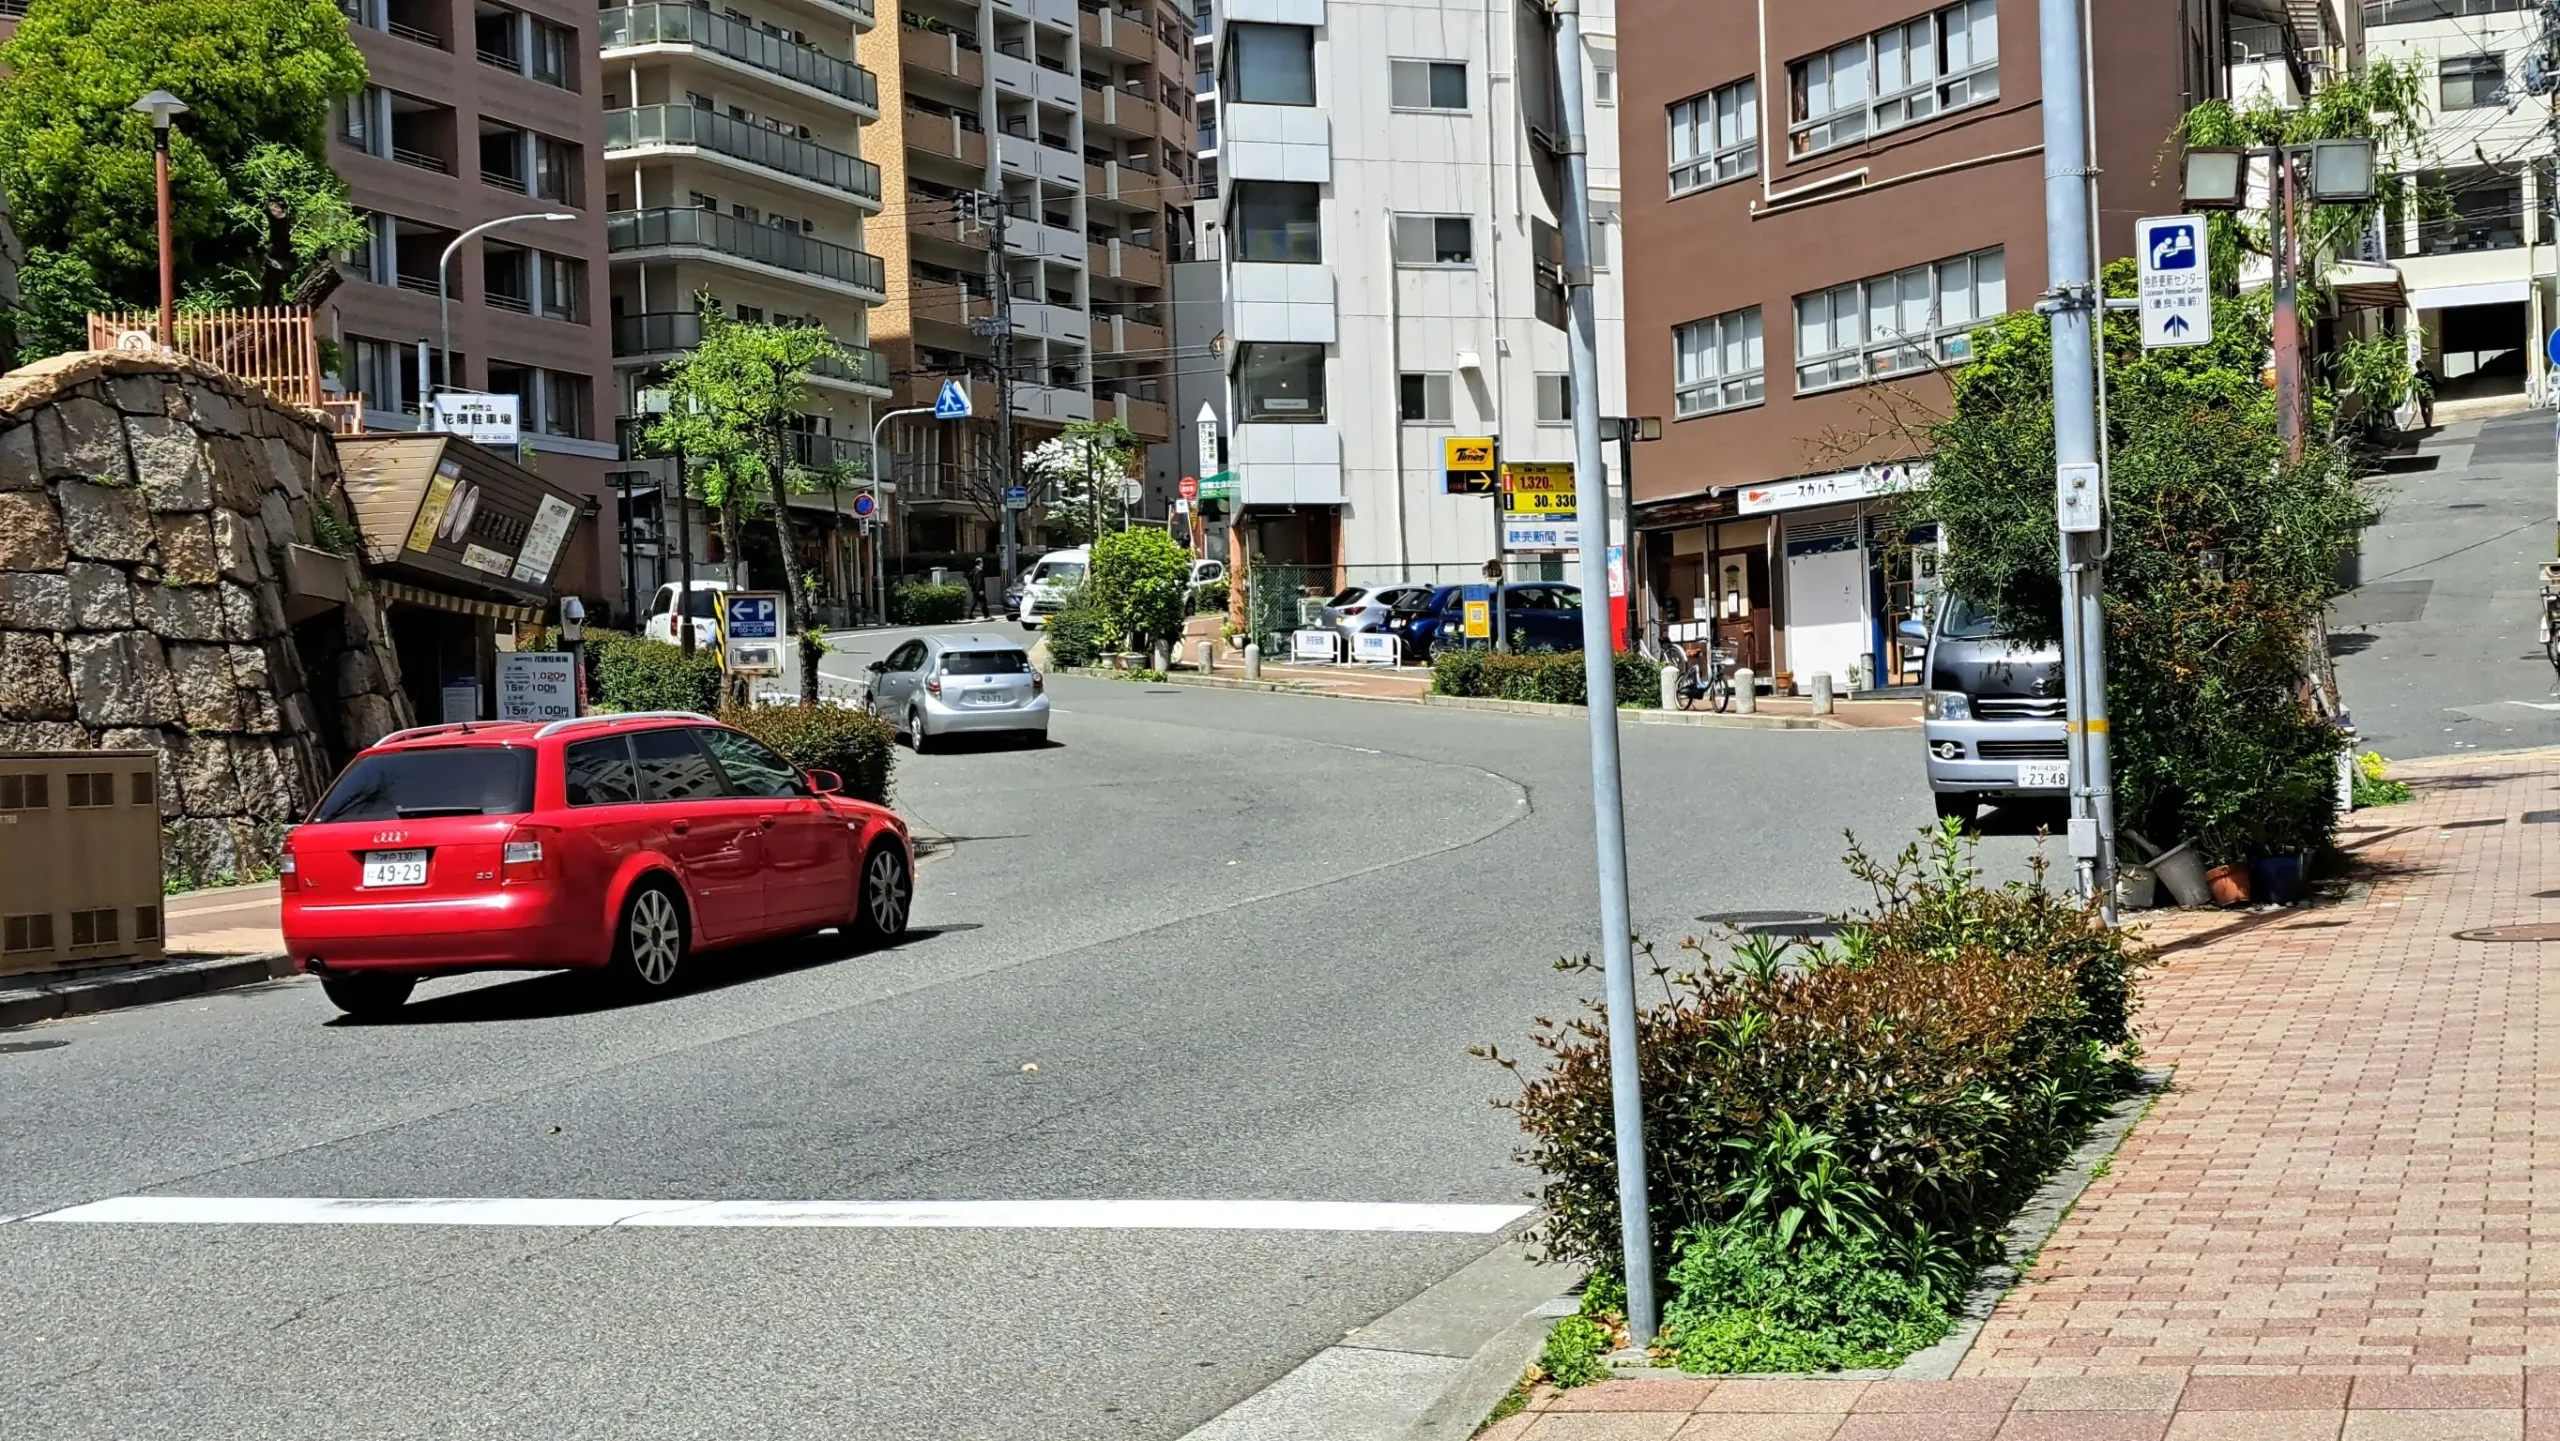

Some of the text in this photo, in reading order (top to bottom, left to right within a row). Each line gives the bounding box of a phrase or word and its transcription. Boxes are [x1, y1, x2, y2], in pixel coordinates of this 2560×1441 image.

[2144, 273, 2204, 288] 免許更新センター
[461, 404, 492, 412] 神戸市立
[443, 413, 512, 425] 花隈駐車場
[1456, 448, 1488, 462] Times
[1509, 530, 1556, 543] 読売新聞
[758, 600, 774, 620] P
[2029, 773, 2066, 786] 23-48
[377, 864, 422, 882] 49-29
